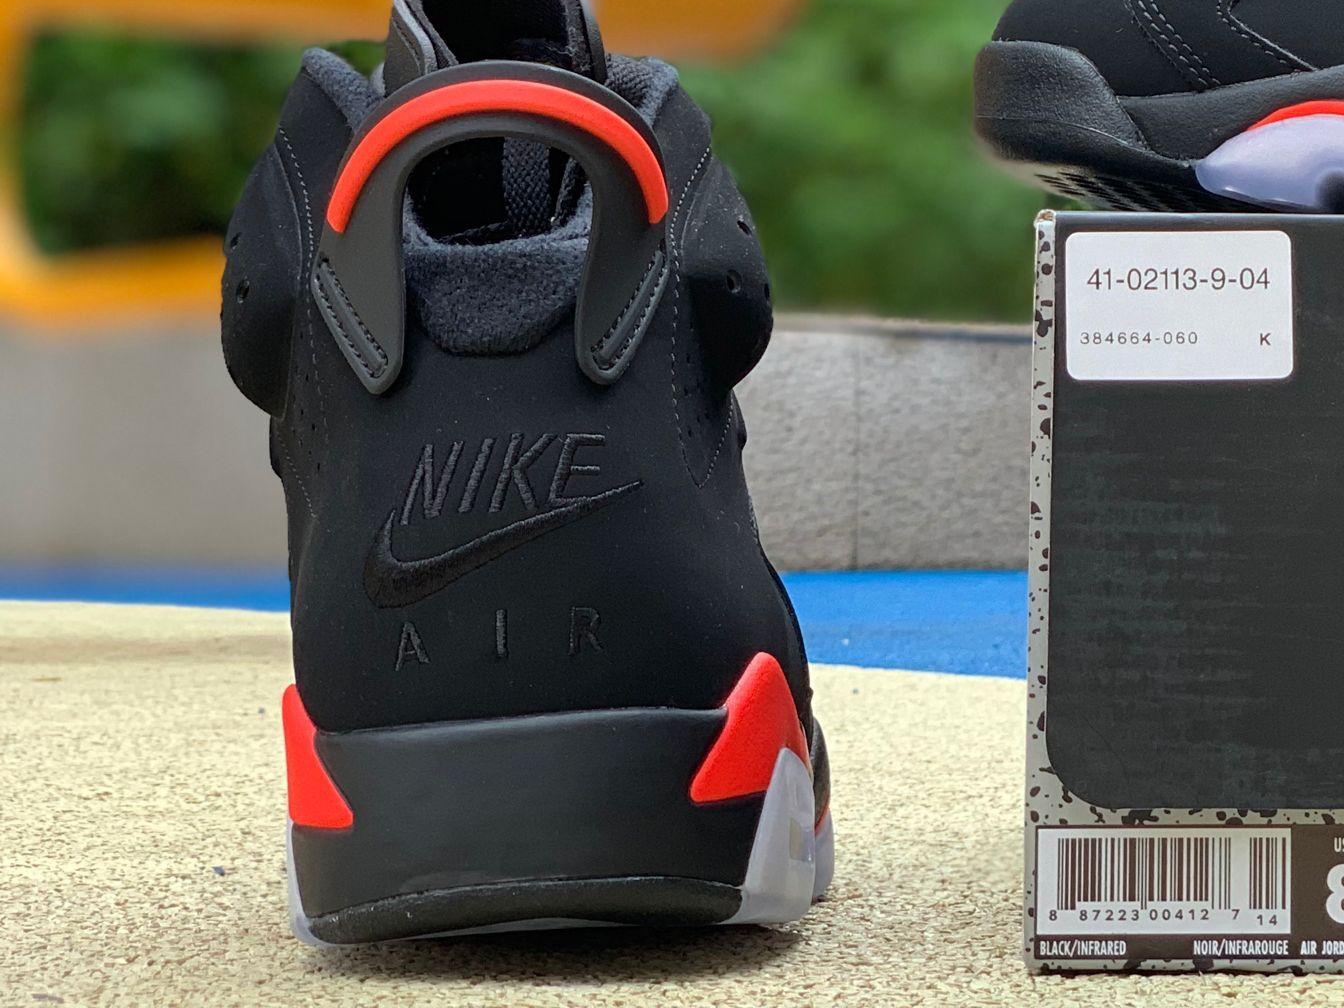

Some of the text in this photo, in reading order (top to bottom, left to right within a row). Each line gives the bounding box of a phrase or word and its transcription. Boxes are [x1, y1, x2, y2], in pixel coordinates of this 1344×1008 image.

[1087, 267, 1270, 290] 41-02113-9-04
[1080, 331, 1271, 346] 384664-060 K
[399, 432, 606, 526] NIKE
[394, 606, 604, 672] AIR
[1049, 908, 1240, 922] 8 87223 00412 7
[1256, 914, 1278, 926] 14
[1039, 939, 1127, 957] BLACK/INFRARED
[1193, 938, 1289, 956] NOIR/INFRAROUGE
[1300, 940, 1317, 956] AIR
